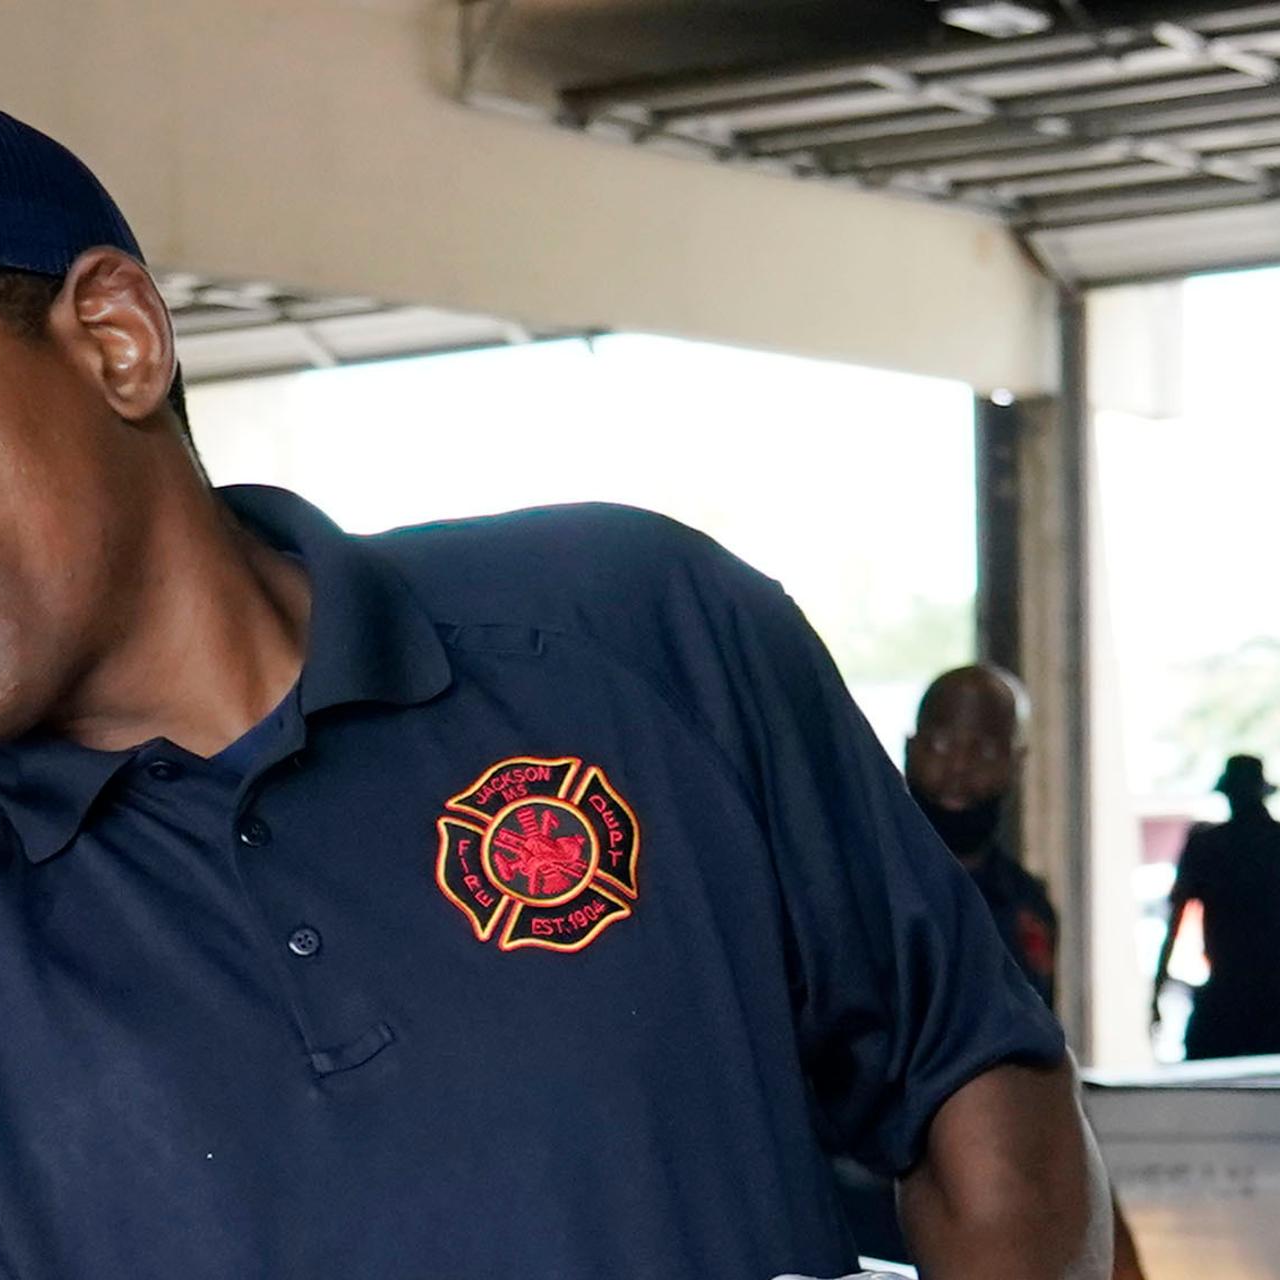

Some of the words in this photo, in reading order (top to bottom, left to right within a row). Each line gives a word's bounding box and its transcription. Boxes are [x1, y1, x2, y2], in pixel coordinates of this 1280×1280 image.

[476, 766, 552, 805] JACKSON
[501, 784, 528, 803] MS
[457, 838, 494, 908] FIRE
